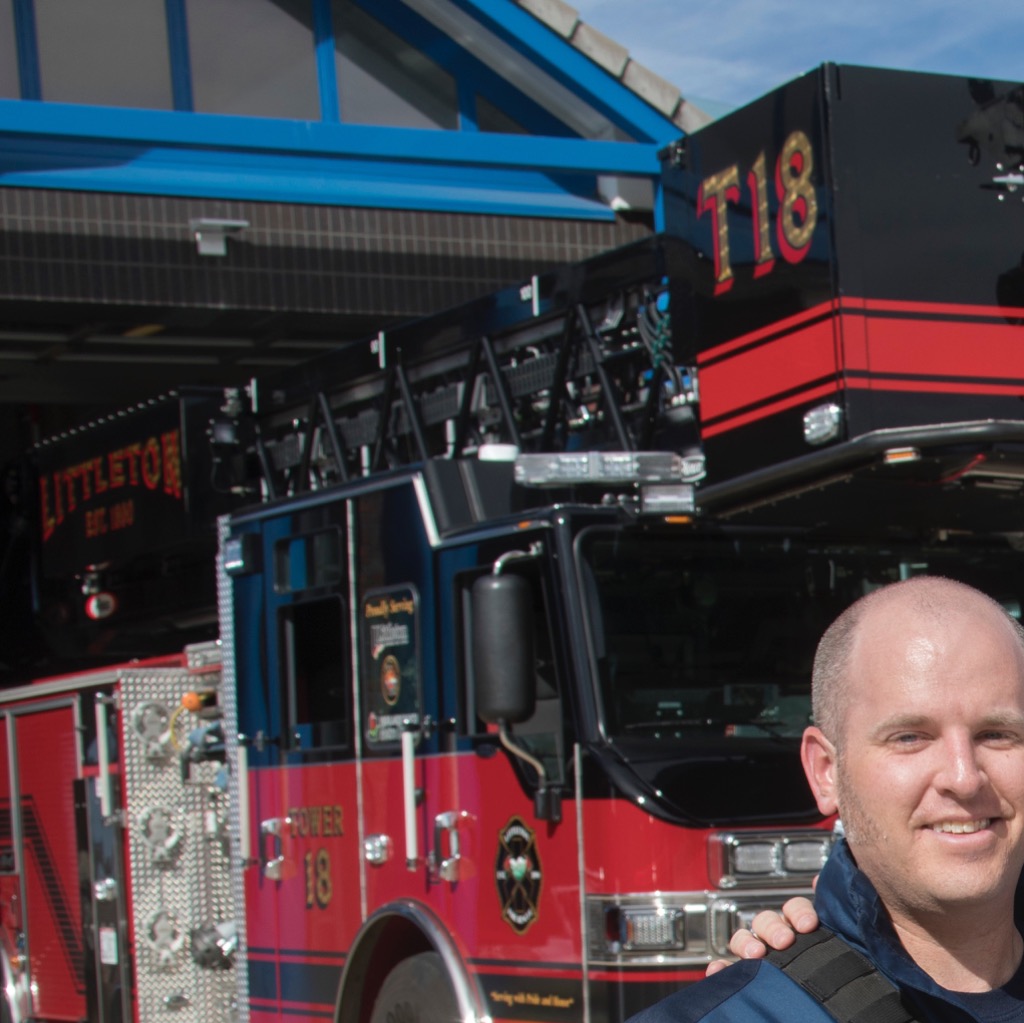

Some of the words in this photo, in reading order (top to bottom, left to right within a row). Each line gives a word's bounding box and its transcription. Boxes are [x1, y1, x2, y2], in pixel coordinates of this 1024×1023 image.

[697, 131, 818, 296] T18
[39, 429, 181, 542] LITTLETON
[288, 805, 344, 839] TOWER
[304, 848, 333, 910] 18
